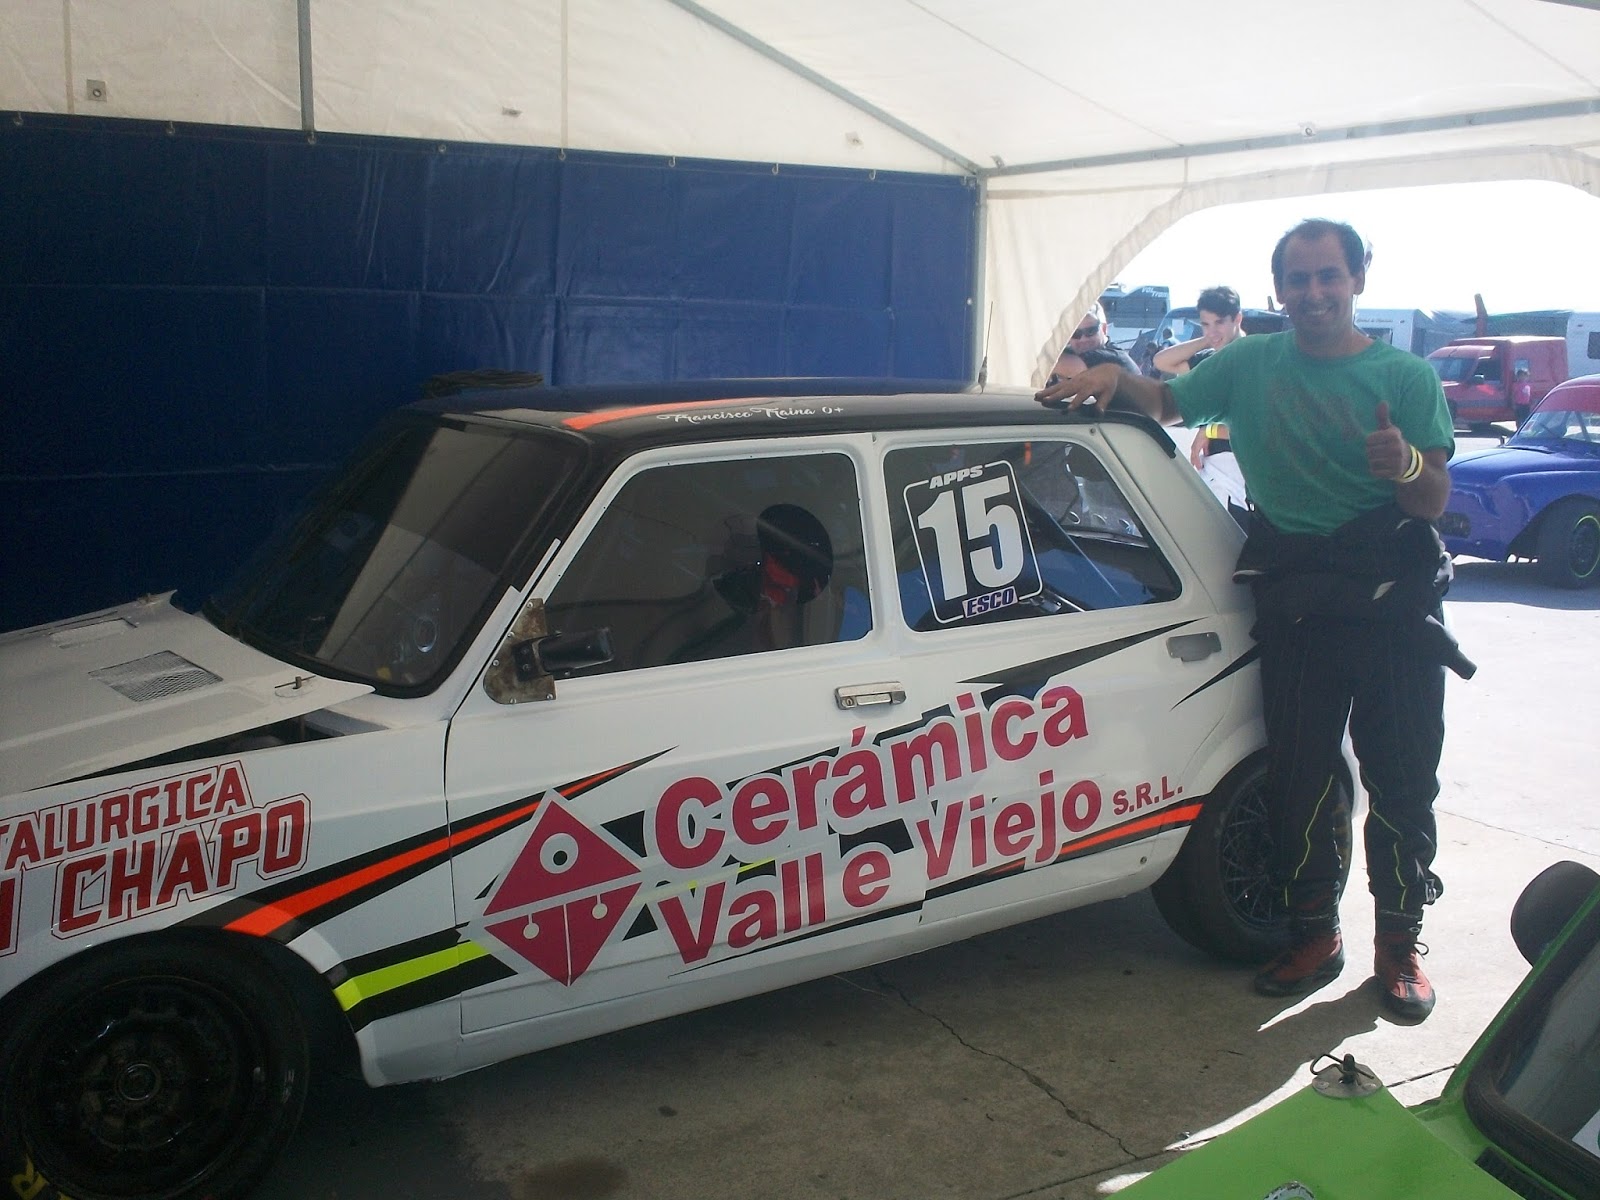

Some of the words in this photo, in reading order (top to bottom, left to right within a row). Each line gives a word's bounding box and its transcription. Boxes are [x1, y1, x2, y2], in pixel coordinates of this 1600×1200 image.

[656, 411, 752, 424] Francisco
[929, 465, 984, 489] APPS
[917, 475, 1024, 601] 15
[965, 588, 1015, 617] ESCO
[655, 685, 1089, 870] Cerámica
[916, 769, 1102, 881] Viejo
[1112, 775, 1183, 816] S.R.L.
[57, 798, 306, 933] CHAPO
